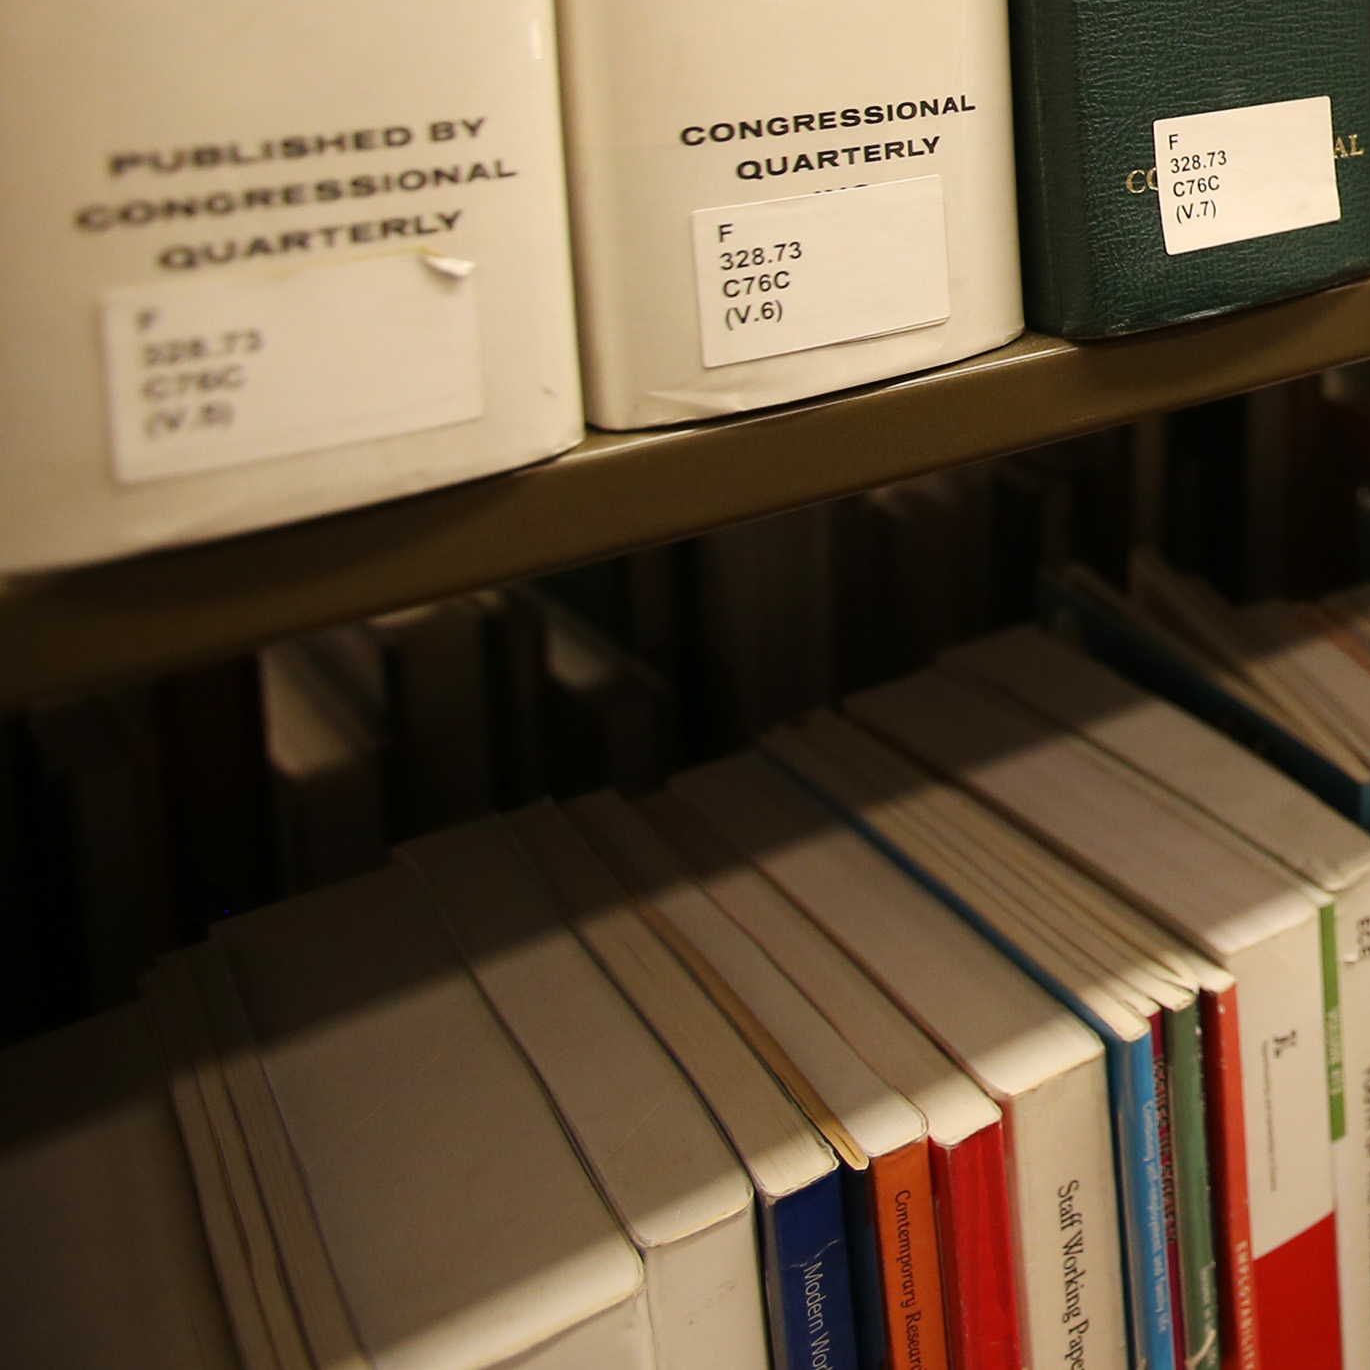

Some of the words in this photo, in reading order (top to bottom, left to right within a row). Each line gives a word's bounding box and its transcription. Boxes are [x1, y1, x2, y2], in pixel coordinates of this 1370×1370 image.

[680, 94, 976, 146] CONGRESSIONAL
[1168, 133, 1179, 150] F
[109, 126, 413, 179] PUBLISHED
[428, 117, 487, 144] BY
[736, 136, 940, 180] QUARTERLY
[1170, 150, 1228, 174] 328.73
[76, 159, 518, 233] CONGRESSIONAL
[1173, 175, 1220, 197] C76C
[717, 223, 734, 243] F
[1176, 199, 1217, 225] (V.7)
[157, 209, 463, 271] QUARTERLY
[719, 241, 803, 271] 328.73
[722, 270, 791, 298] C76C
[724, 299, 783, 331] (V.6)
[1057, 1180, 1084, 1231] Staff
[894, 1190, 917, 1308] Contemporary
[802, 1262, 828, 1334] Modern
[1062, 1231, 1088, 1323] Working
[809, 1331, 834, 1370] Wor
[904, 1310, 927, 1370] Researc
[1063, 1318, 1090, 1370] Pape
